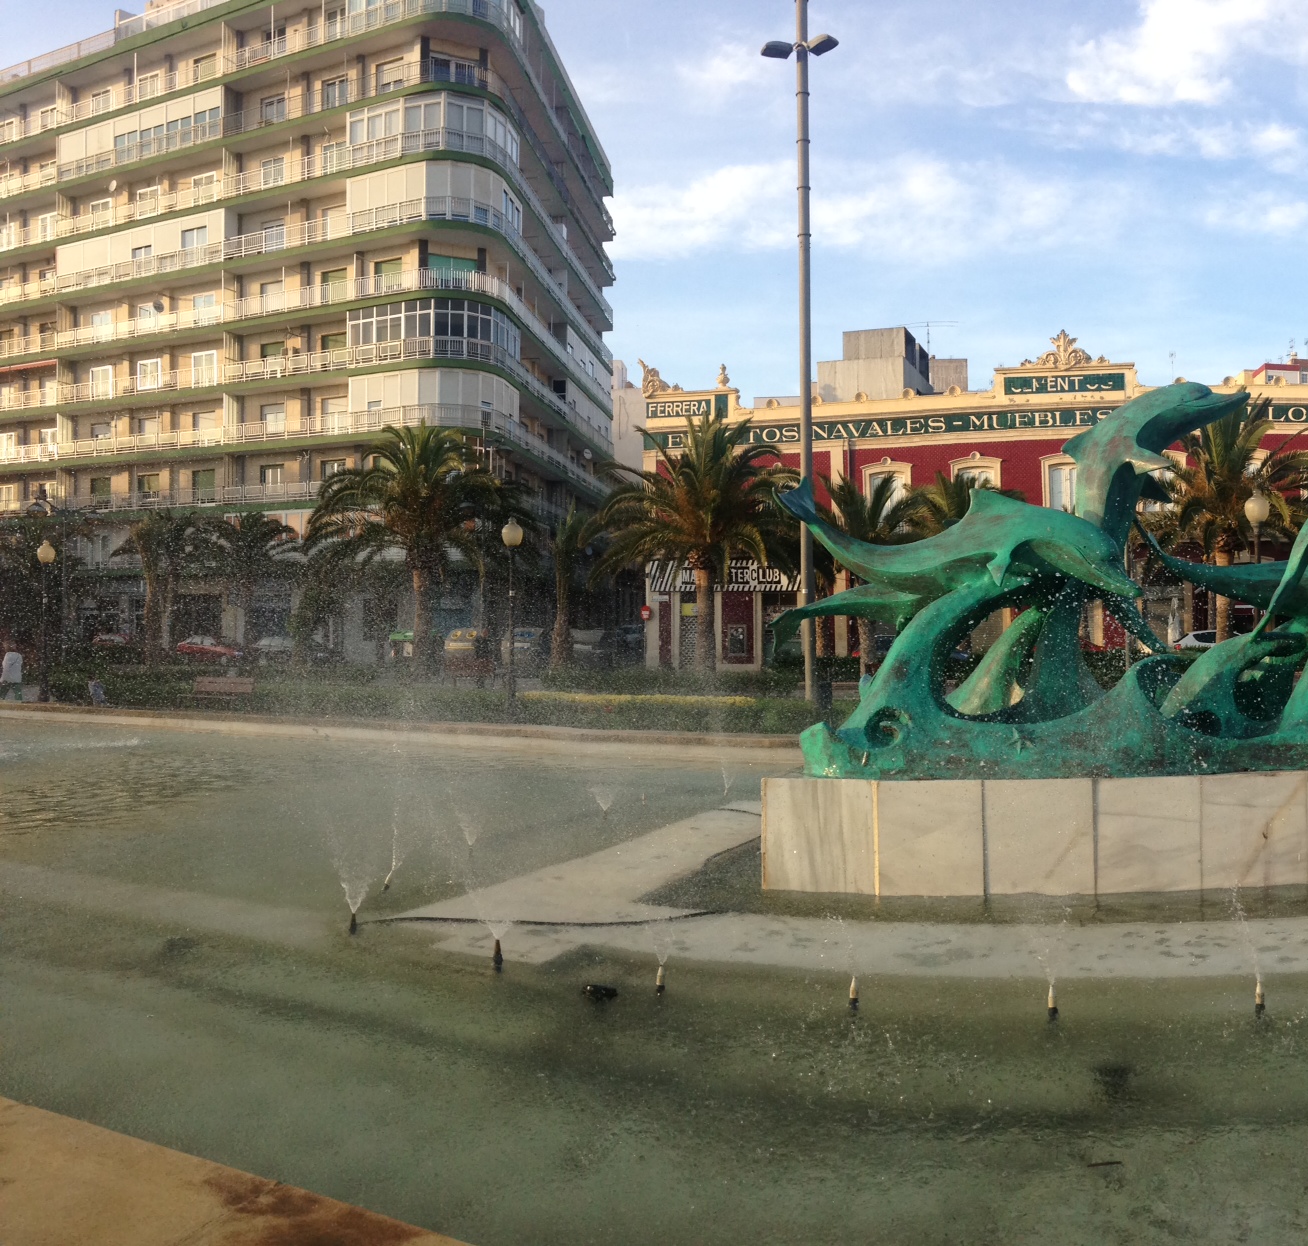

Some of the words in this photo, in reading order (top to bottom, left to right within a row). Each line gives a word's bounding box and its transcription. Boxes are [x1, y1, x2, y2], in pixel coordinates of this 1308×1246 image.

[1011, 376, 1113, 393] MENT
[648, 400, 708, 417] FERRERA
[667, 426, 799, 448] ETOS
[812, 417, 946, 440] NAVALES
[969, 409, 1113, 430] MUEBLES
